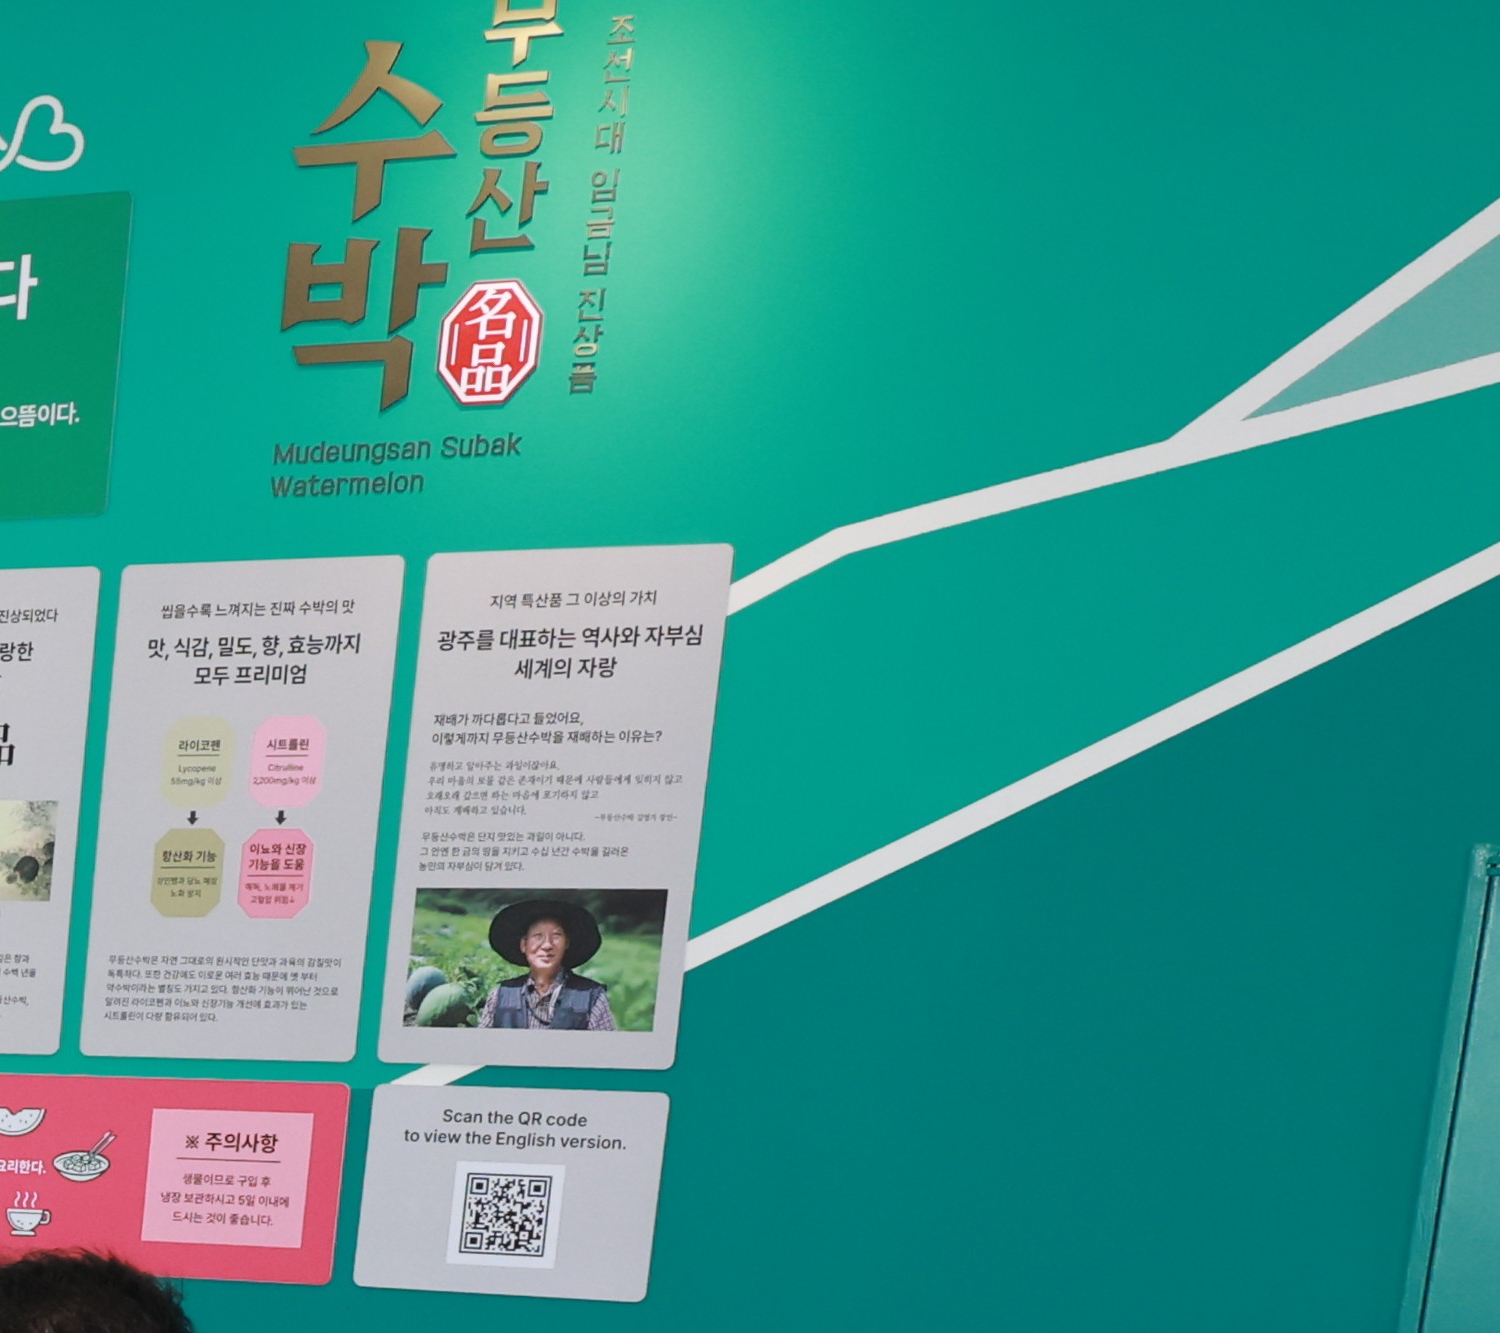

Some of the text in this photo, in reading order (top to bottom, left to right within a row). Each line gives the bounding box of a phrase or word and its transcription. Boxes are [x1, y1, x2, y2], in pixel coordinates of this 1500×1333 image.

[569, 14, 636, 396] 조선시대 임금님 진상품
[281, 40, 457, 413] 수박
[461, 286, 516, 394] 名品
[272, 432, 522, 465] Mudeungsan Subak
[271, 471, 425, 498] Watermelon
[160, 598, 355, 619] 씹을수록 느껴지는 진짜 수박의 맛
[490, 589, 657, 609] 지역 특산품 그 이상의 가치
[147, 632, 361, 661] 맛, 식감, 밀도, 향, 효능까지
[437, 623, 703, 651] 광주를 대표하는 역사와 자부심
[193, 663, 307, 686] 모두 프리미엄
[514, 656, 617, 679] 세계의 자랑
[442, 1108, 587, 1127] Scan the QR code
[205, 1132, 278, 1153] 주의사항
[404, 1129, 626, 1150] to view the English version.
